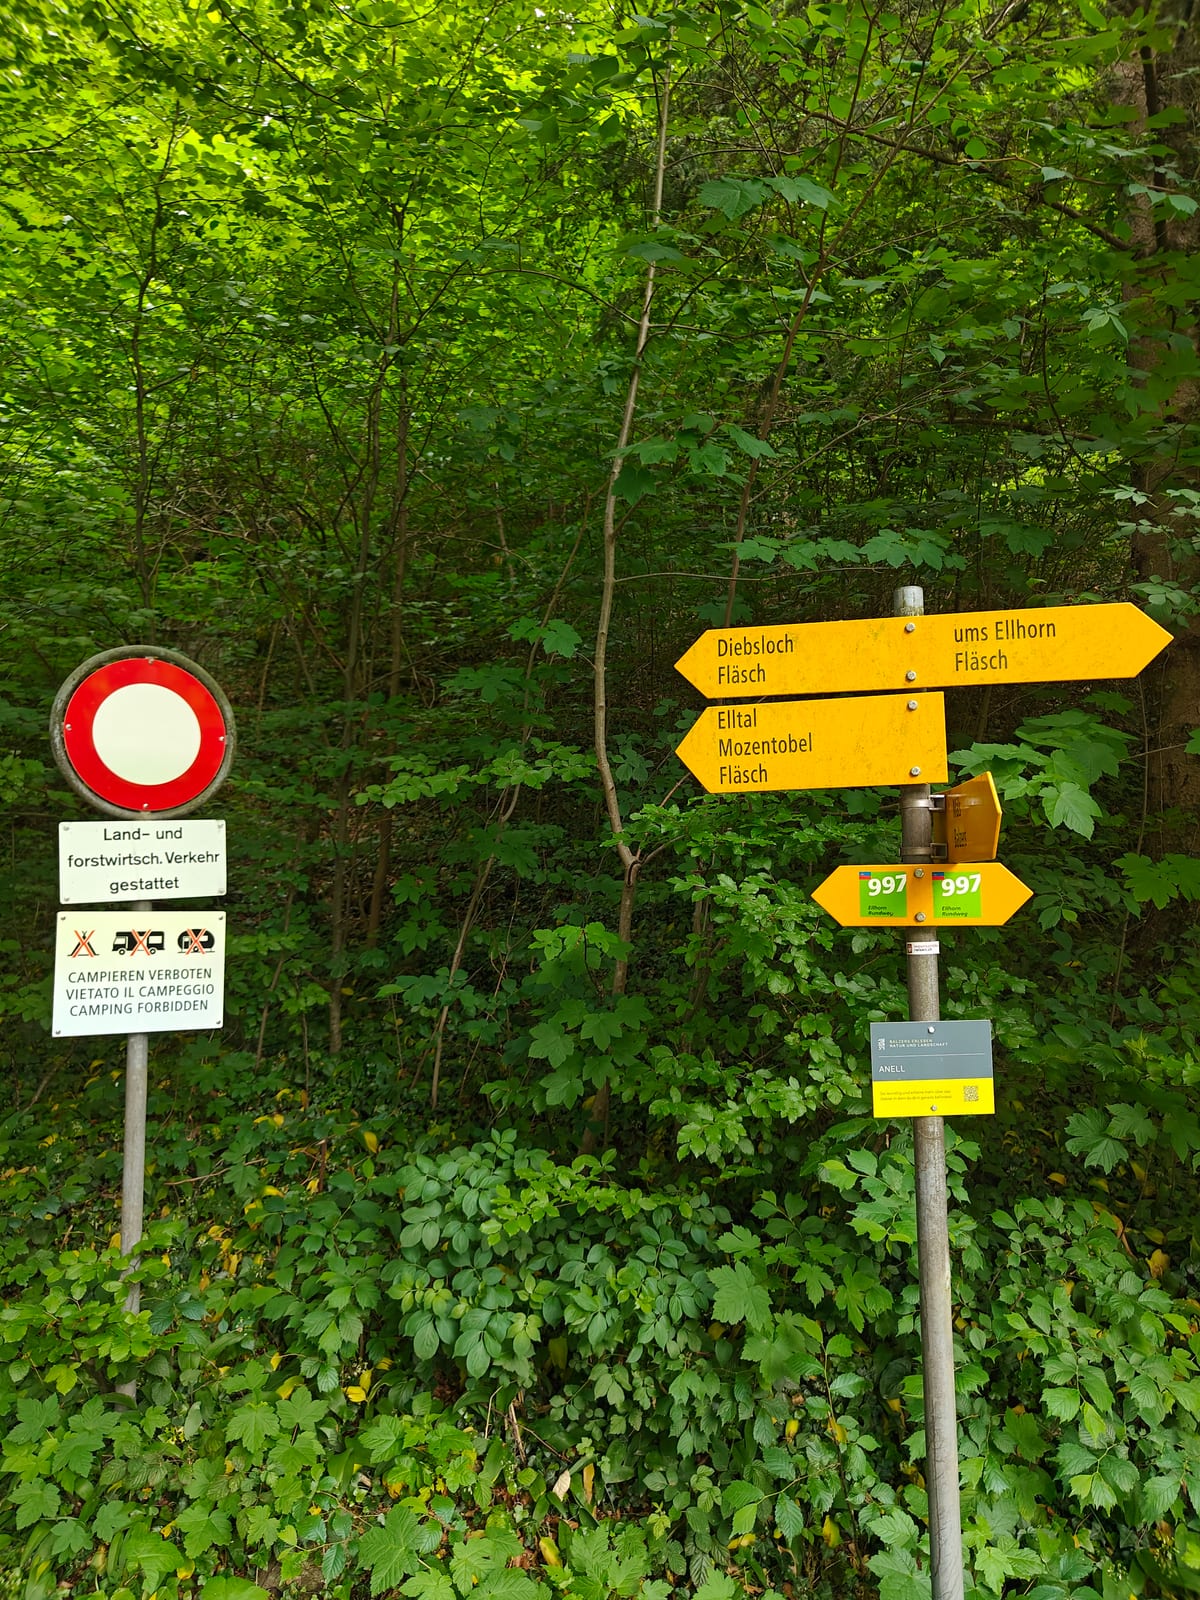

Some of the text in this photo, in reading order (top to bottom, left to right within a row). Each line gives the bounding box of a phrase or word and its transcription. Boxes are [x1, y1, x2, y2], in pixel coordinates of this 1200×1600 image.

[954, 618, 1056, 643] ums Ellhorn
[718, 633, 794, 657] Diebsloch
[955, 649, 1008, 671] Fläsch
[718, 663, 766, 685] Fläsch
[718, 707, 757, 729] Elltal
[719, 732, 812, 757] Mozentobel
[720, 763, 768, 784] Fläsch
[103, 827, 183, 841] Land- und
[67, 851, 220, 868] forstwirtsch. Verkehr
[109, 876, 180, 894] gestattet
[867, 873, 907, 897] 997
[941, 873, 982, 897] 997
[68, 968, 212, 983] CAMPIEREN VERBOTEN
[66, 984, 215, 1000] VIETATO IL CAMPEGGIO
[69, 1000, 209, 1017] CAMPING FORBIDDEN
[878, 1065, 906, 1073] ANELL
